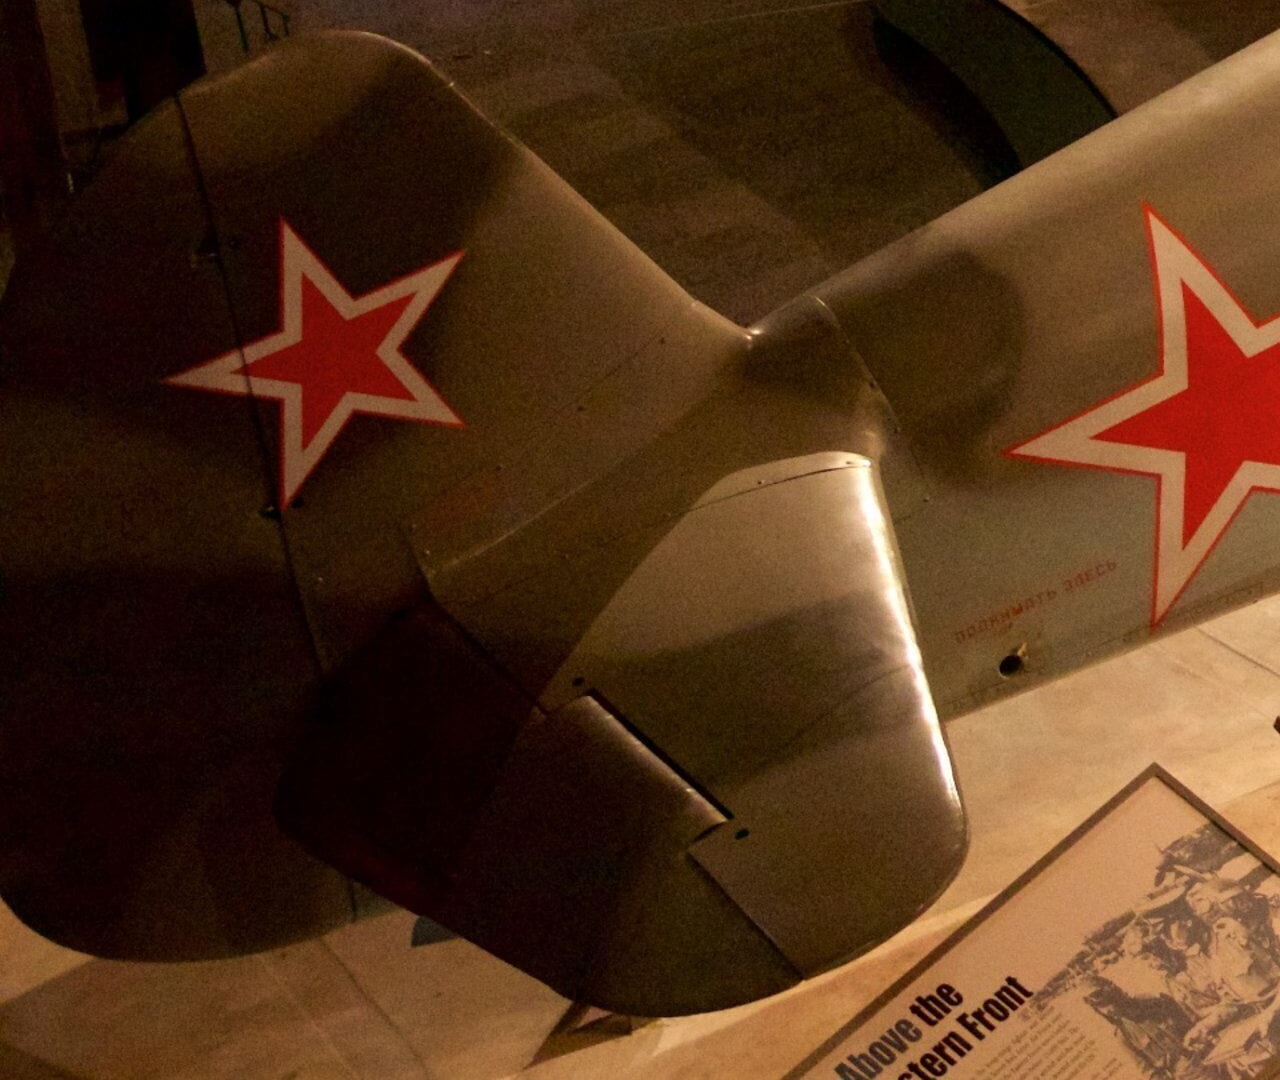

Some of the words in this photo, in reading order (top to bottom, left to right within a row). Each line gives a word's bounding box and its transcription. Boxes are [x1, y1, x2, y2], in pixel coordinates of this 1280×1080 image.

[833, 1018, 923, 1080] Above
[909, 983, 964, 1027] the
[955, 975, 1034, 1041] Front
